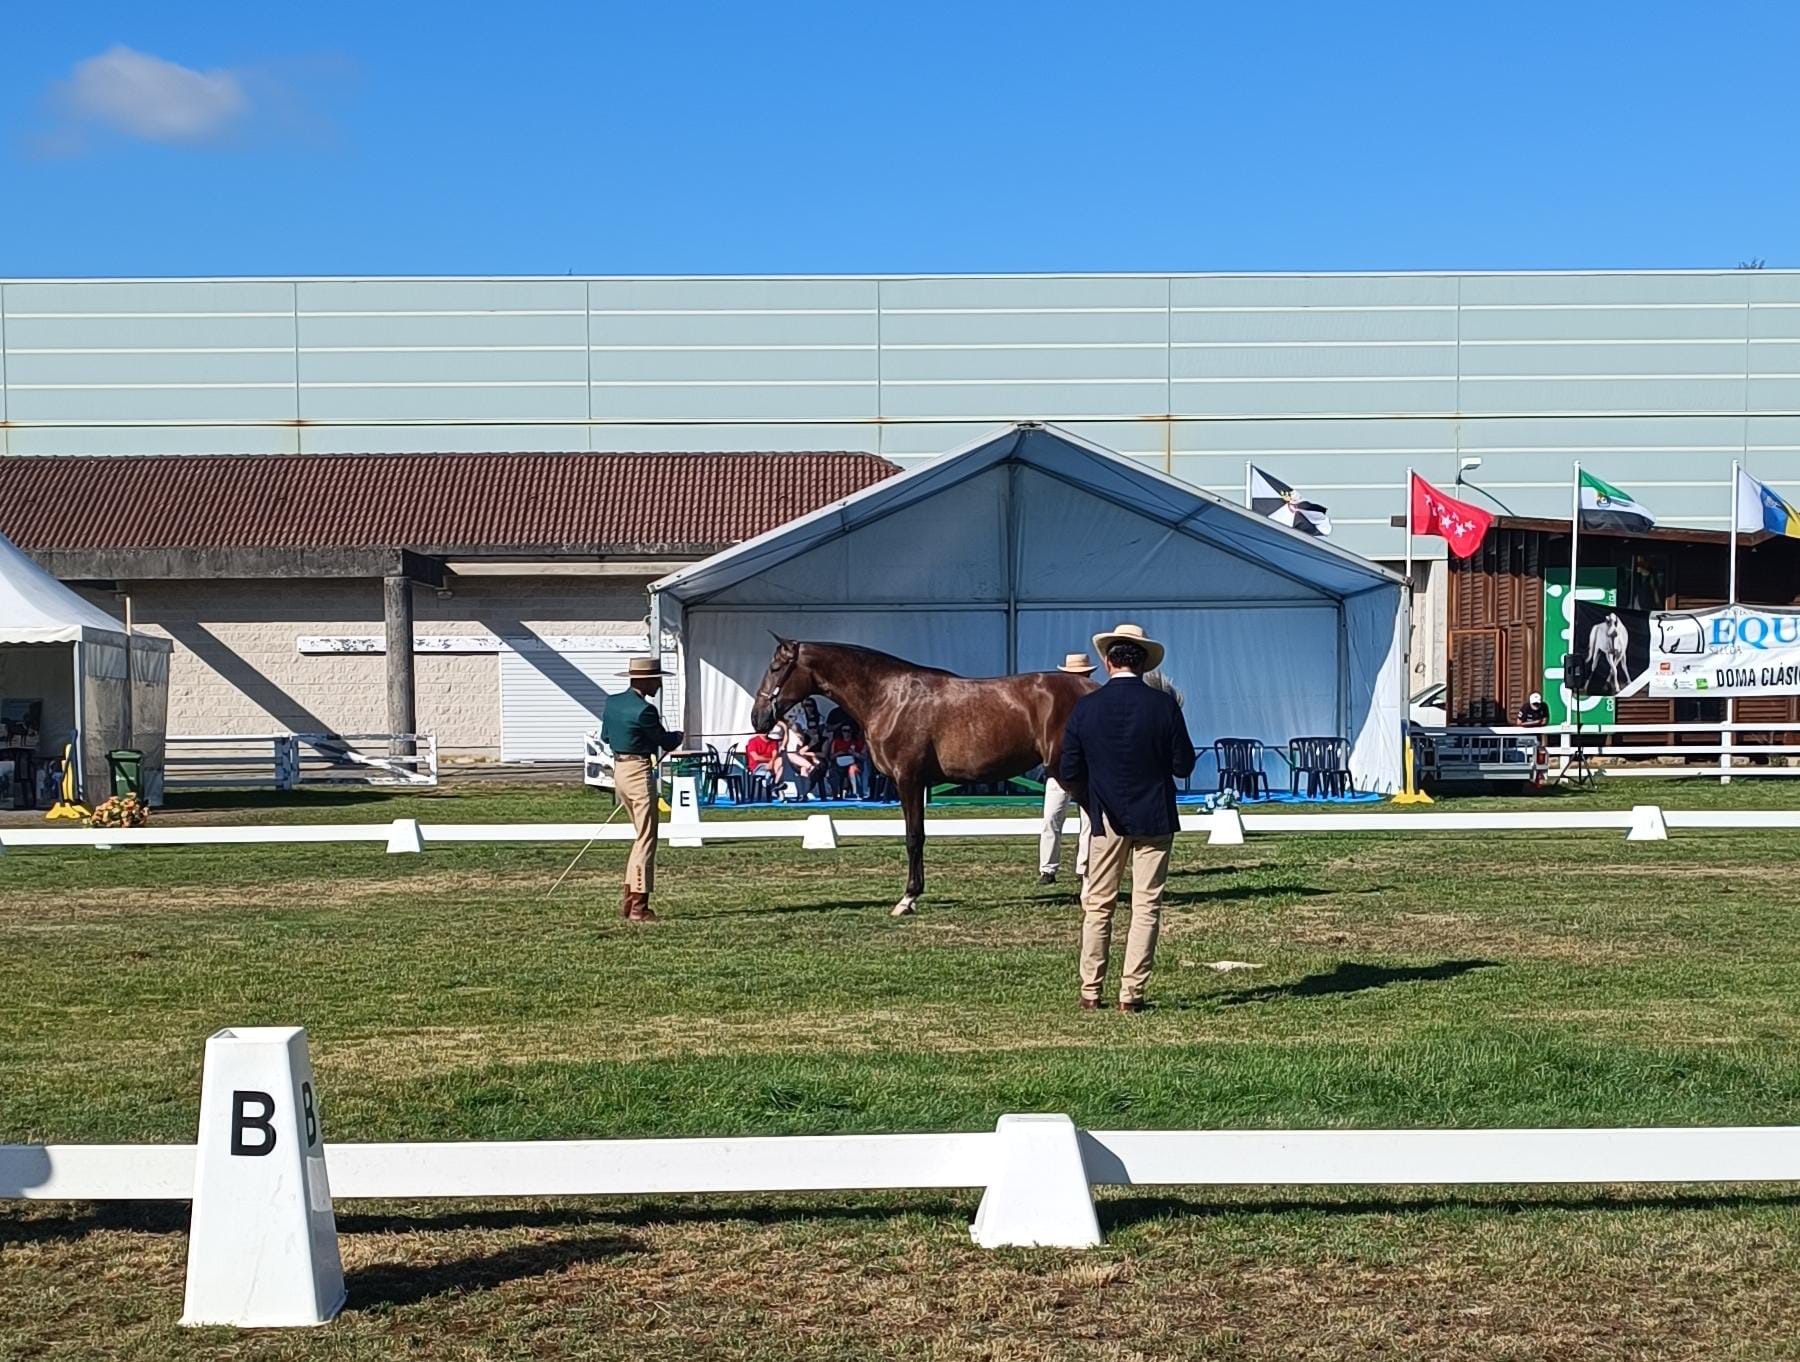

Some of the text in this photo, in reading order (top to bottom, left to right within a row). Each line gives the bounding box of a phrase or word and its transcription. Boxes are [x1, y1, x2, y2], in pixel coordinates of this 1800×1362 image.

[1709, 616, 1800, 649] EQU
[1716, 668, 1756, 688] DOMA
[1761, 661, 1800, 687] CLÁSI
[680, 791, 690, 807] E
[231, 1090, 277, 1156] B
[302, 1081, 317, 1148] B
